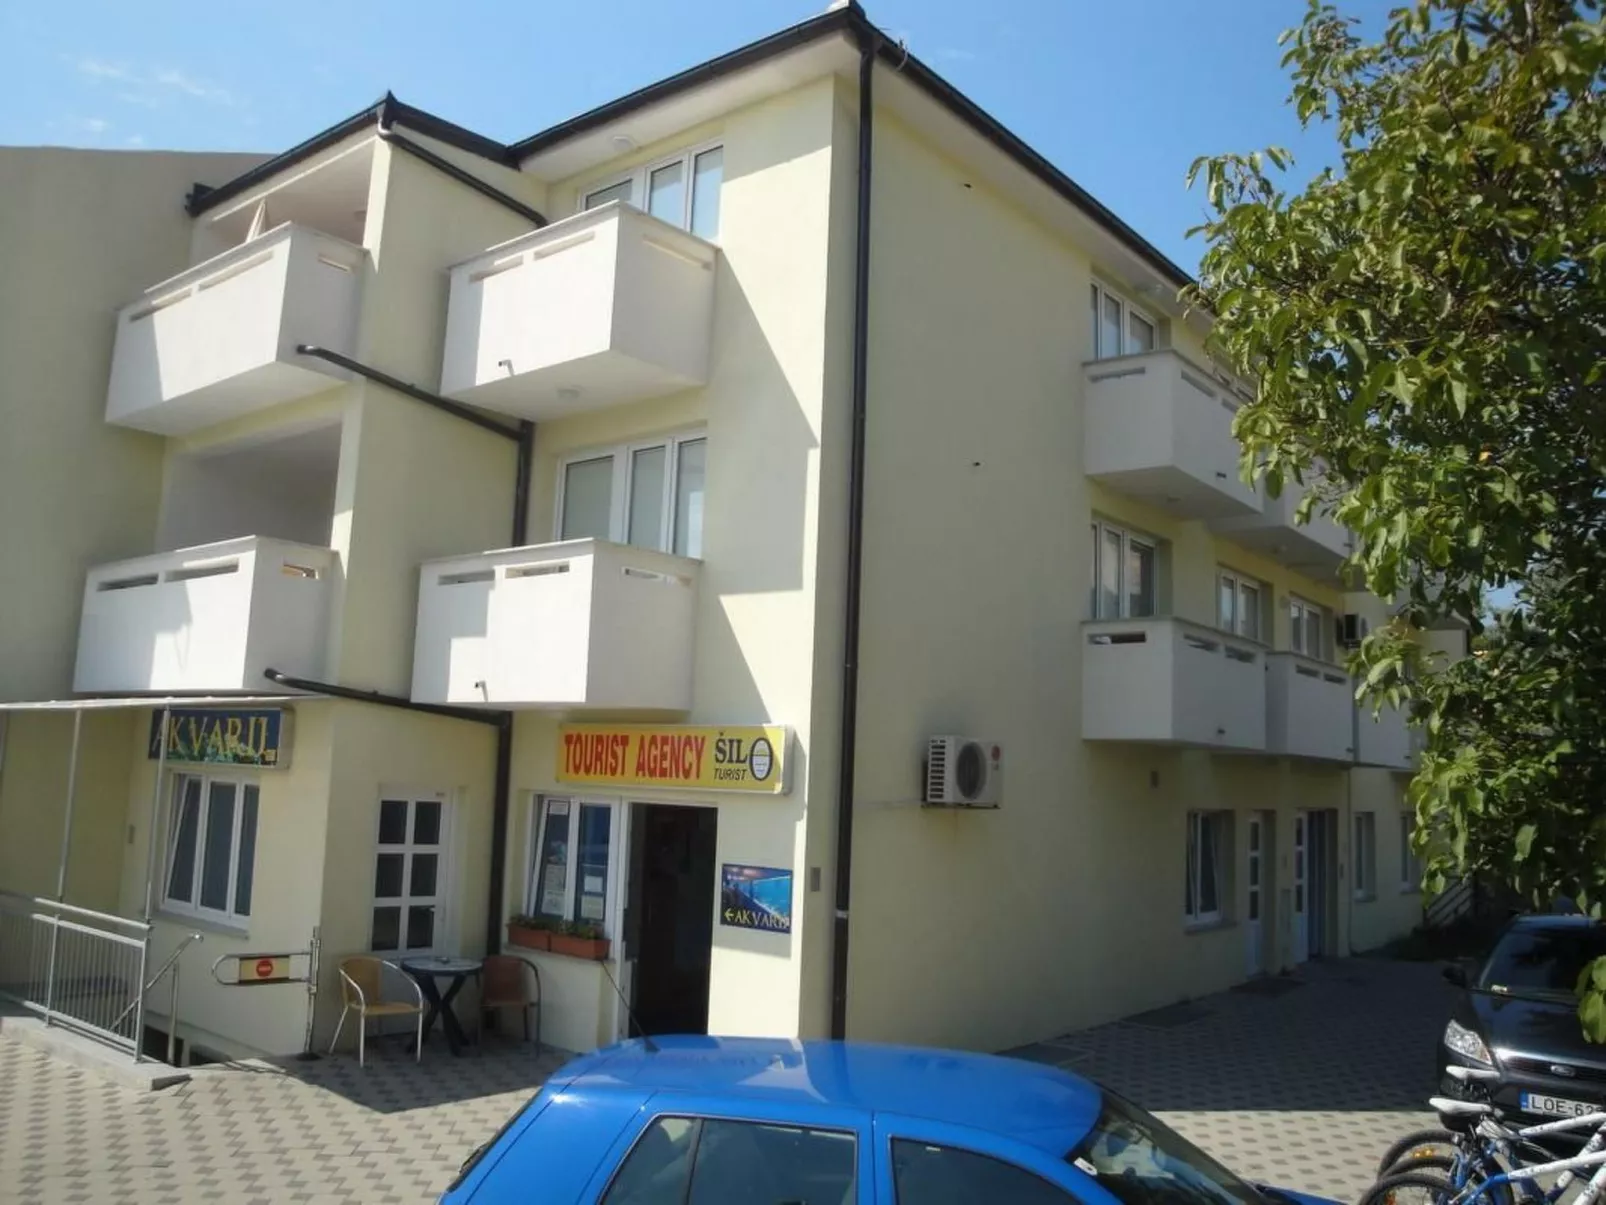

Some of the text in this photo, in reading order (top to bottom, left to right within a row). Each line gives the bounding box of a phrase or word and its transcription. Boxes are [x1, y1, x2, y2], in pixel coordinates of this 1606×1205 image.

[564, 732, 706, 780] TOURIST AGENCY
[714, 768, 748, 780] TURIST
